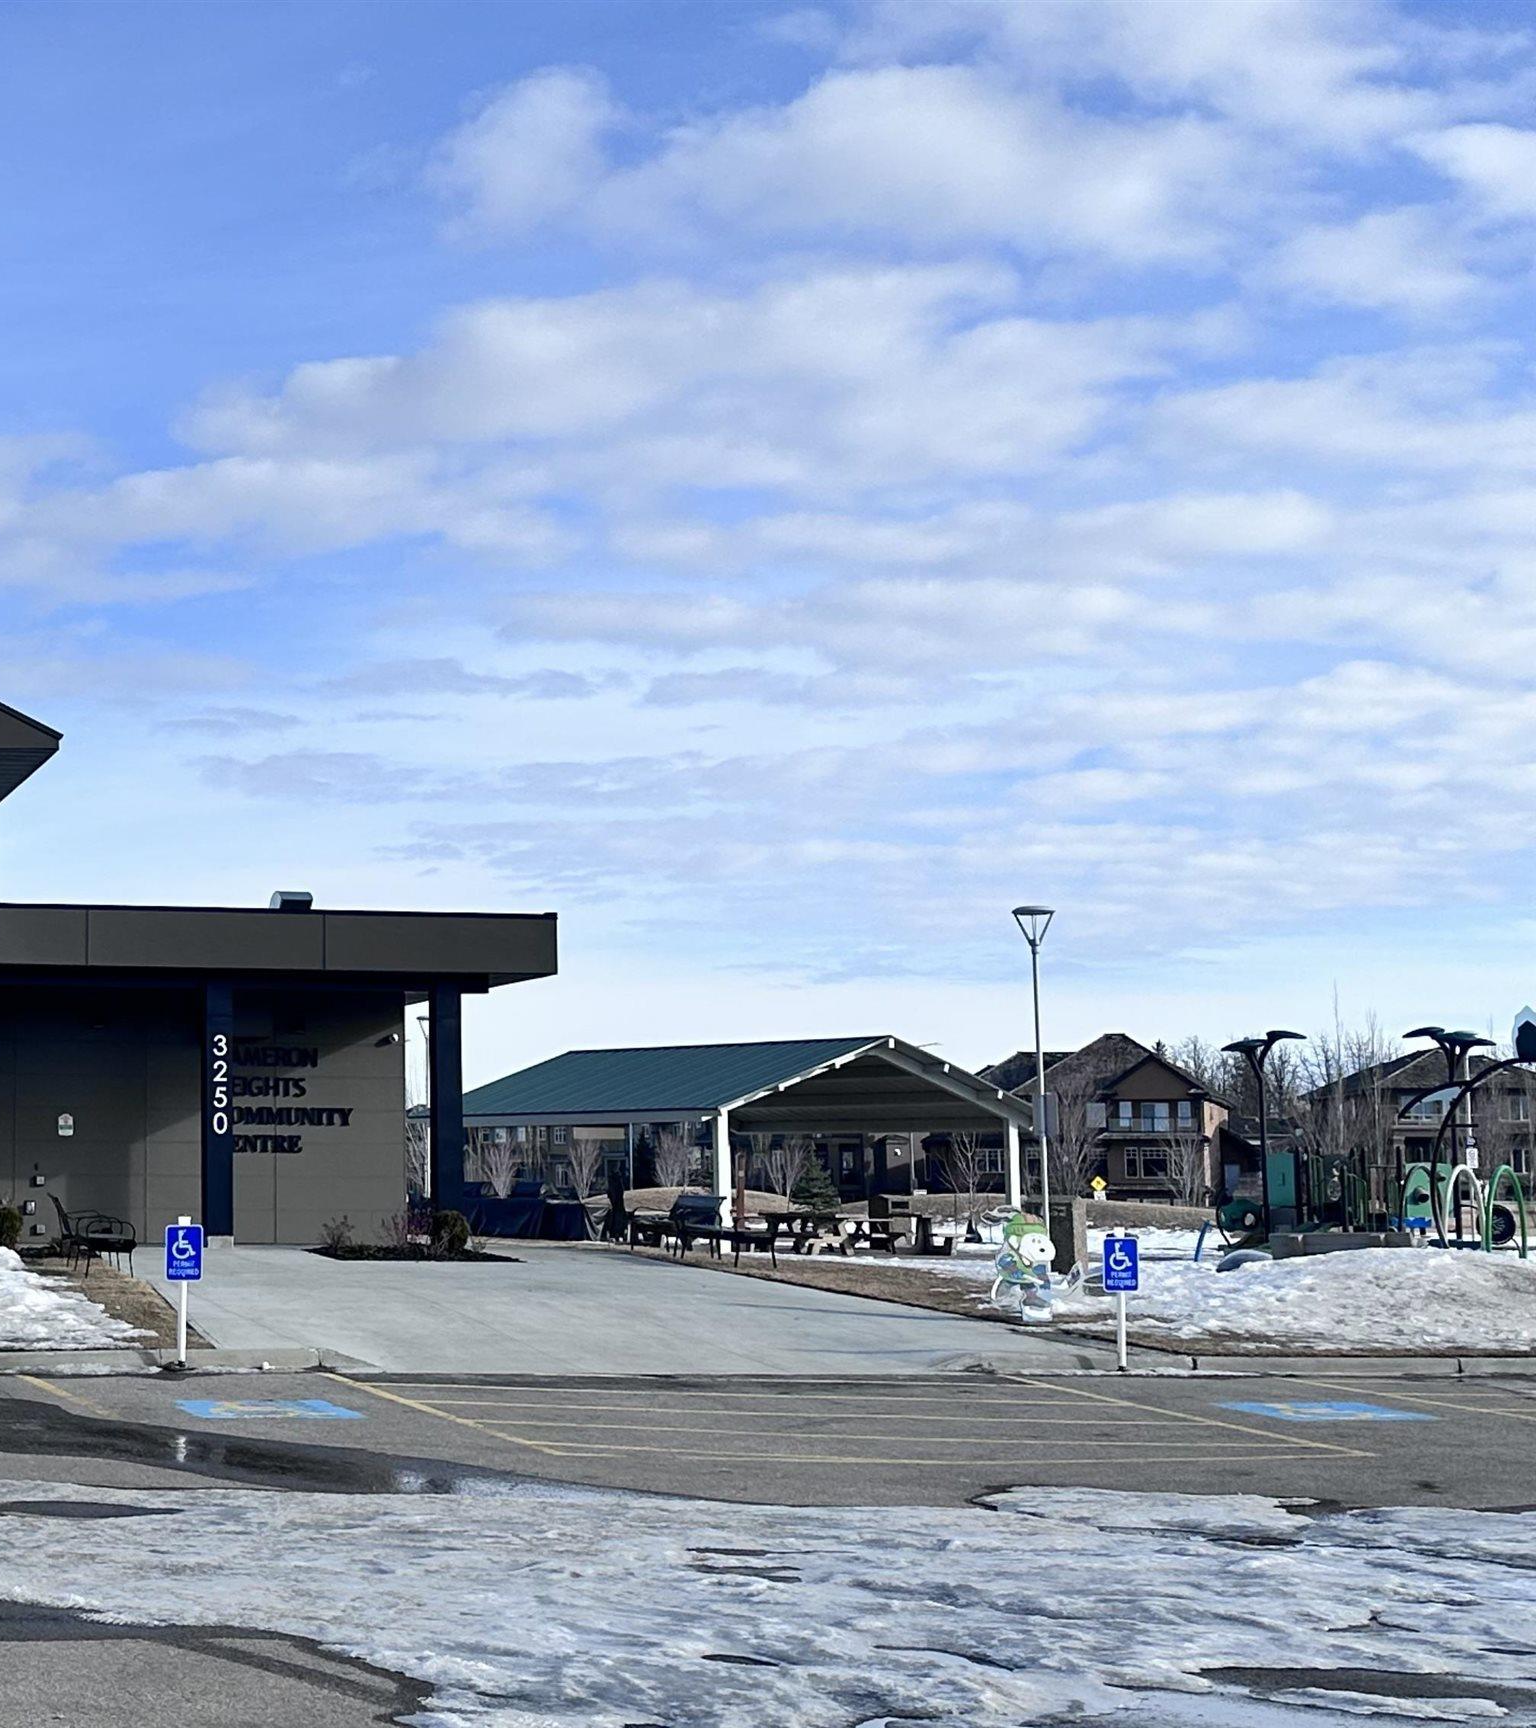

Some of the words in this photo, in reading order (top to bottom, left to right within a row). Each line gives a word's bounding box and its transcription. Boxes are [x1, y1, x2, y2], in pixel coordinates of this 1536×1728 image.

[232, 1047, 318, 1067] AMERON
[213, 1034, 228, 1135] 3250
[232, 1077, 306, 1097] EIGHTS
[232, 1106, 353, 1126] OMMUNITY
[232, 1135, 303, 1153] ENTRE
